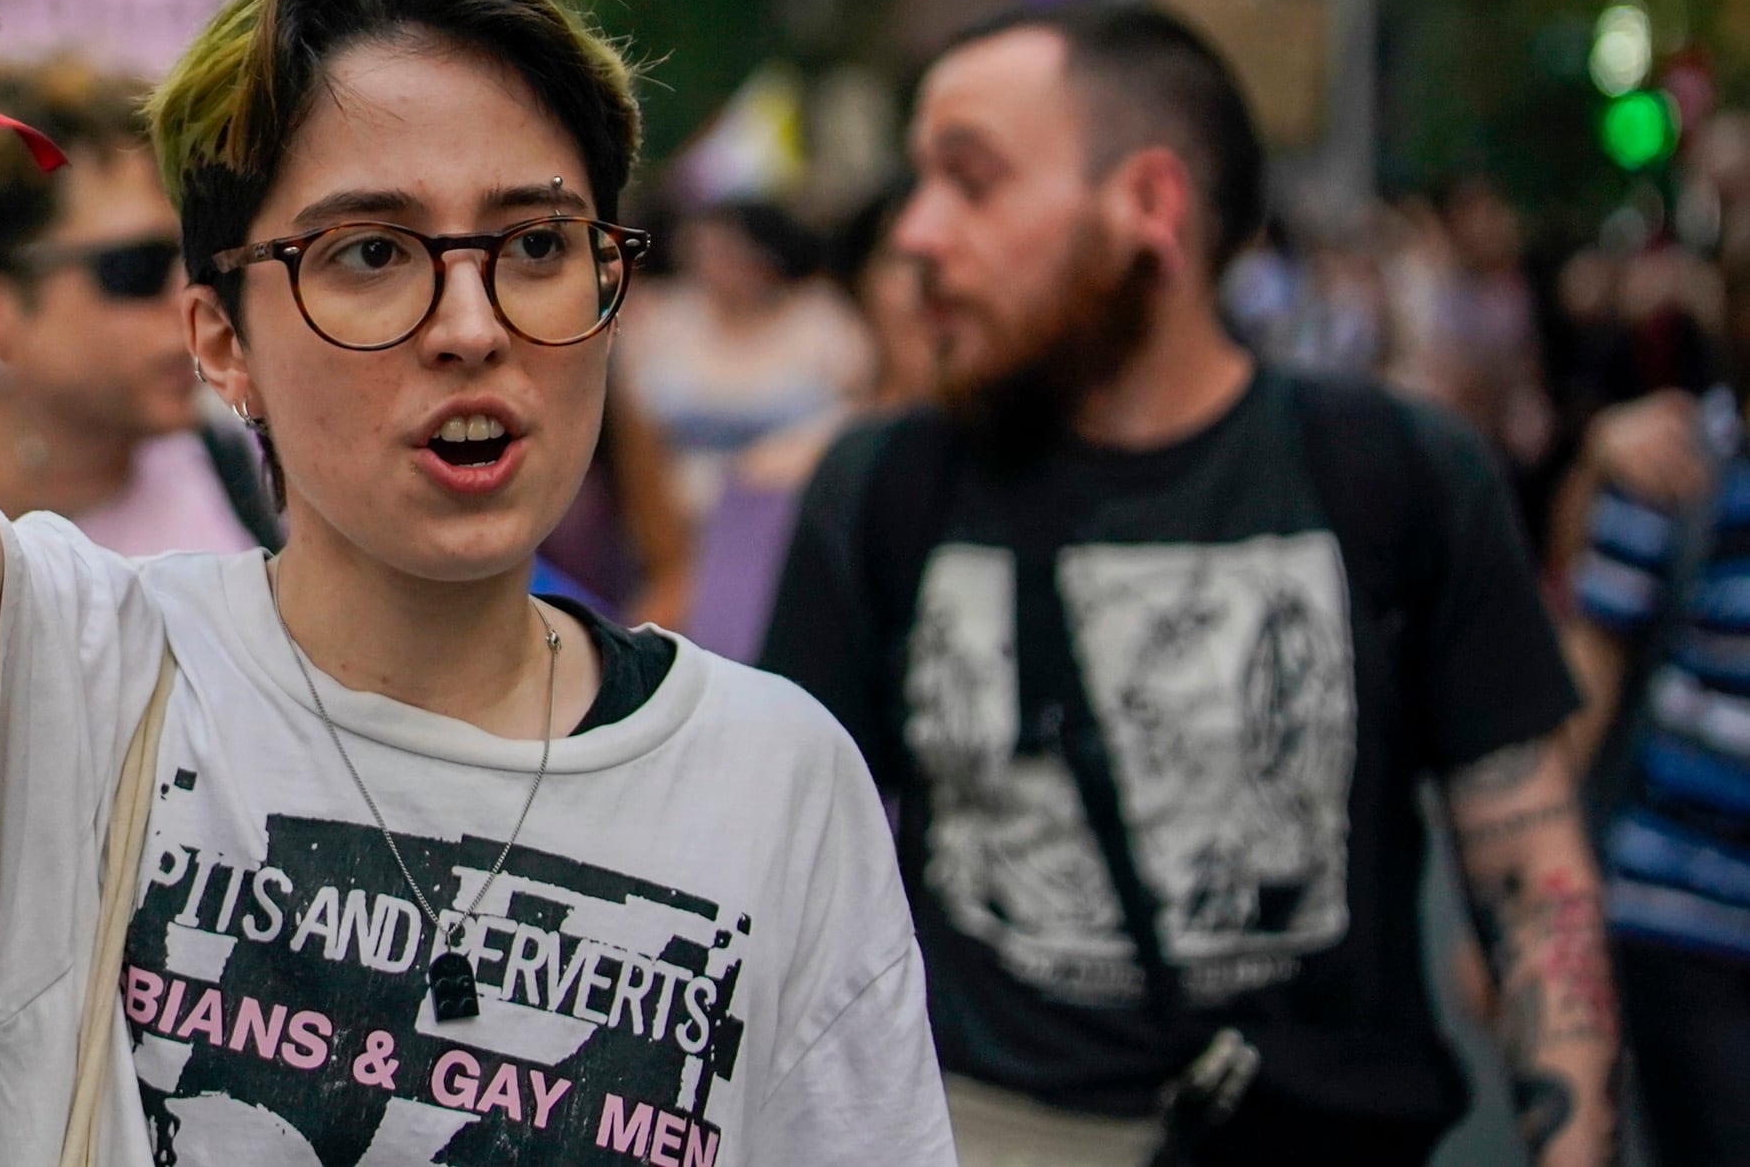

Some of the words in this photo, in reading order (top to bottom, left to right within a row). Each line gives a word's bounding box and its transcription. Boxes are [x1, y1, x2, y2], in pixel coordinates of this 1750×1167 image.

[137, 842, 294, 943] PITS
[290, 886, 423, 974] AND
[426, 908, 717, 1054] PERVERTS
[120, 964, 333, 1069] BIANS
[353, 1030, 399, 1090] &
[431, 1049, 572, 1128] GAY
[595, 1092, 720, 1167] MEN
